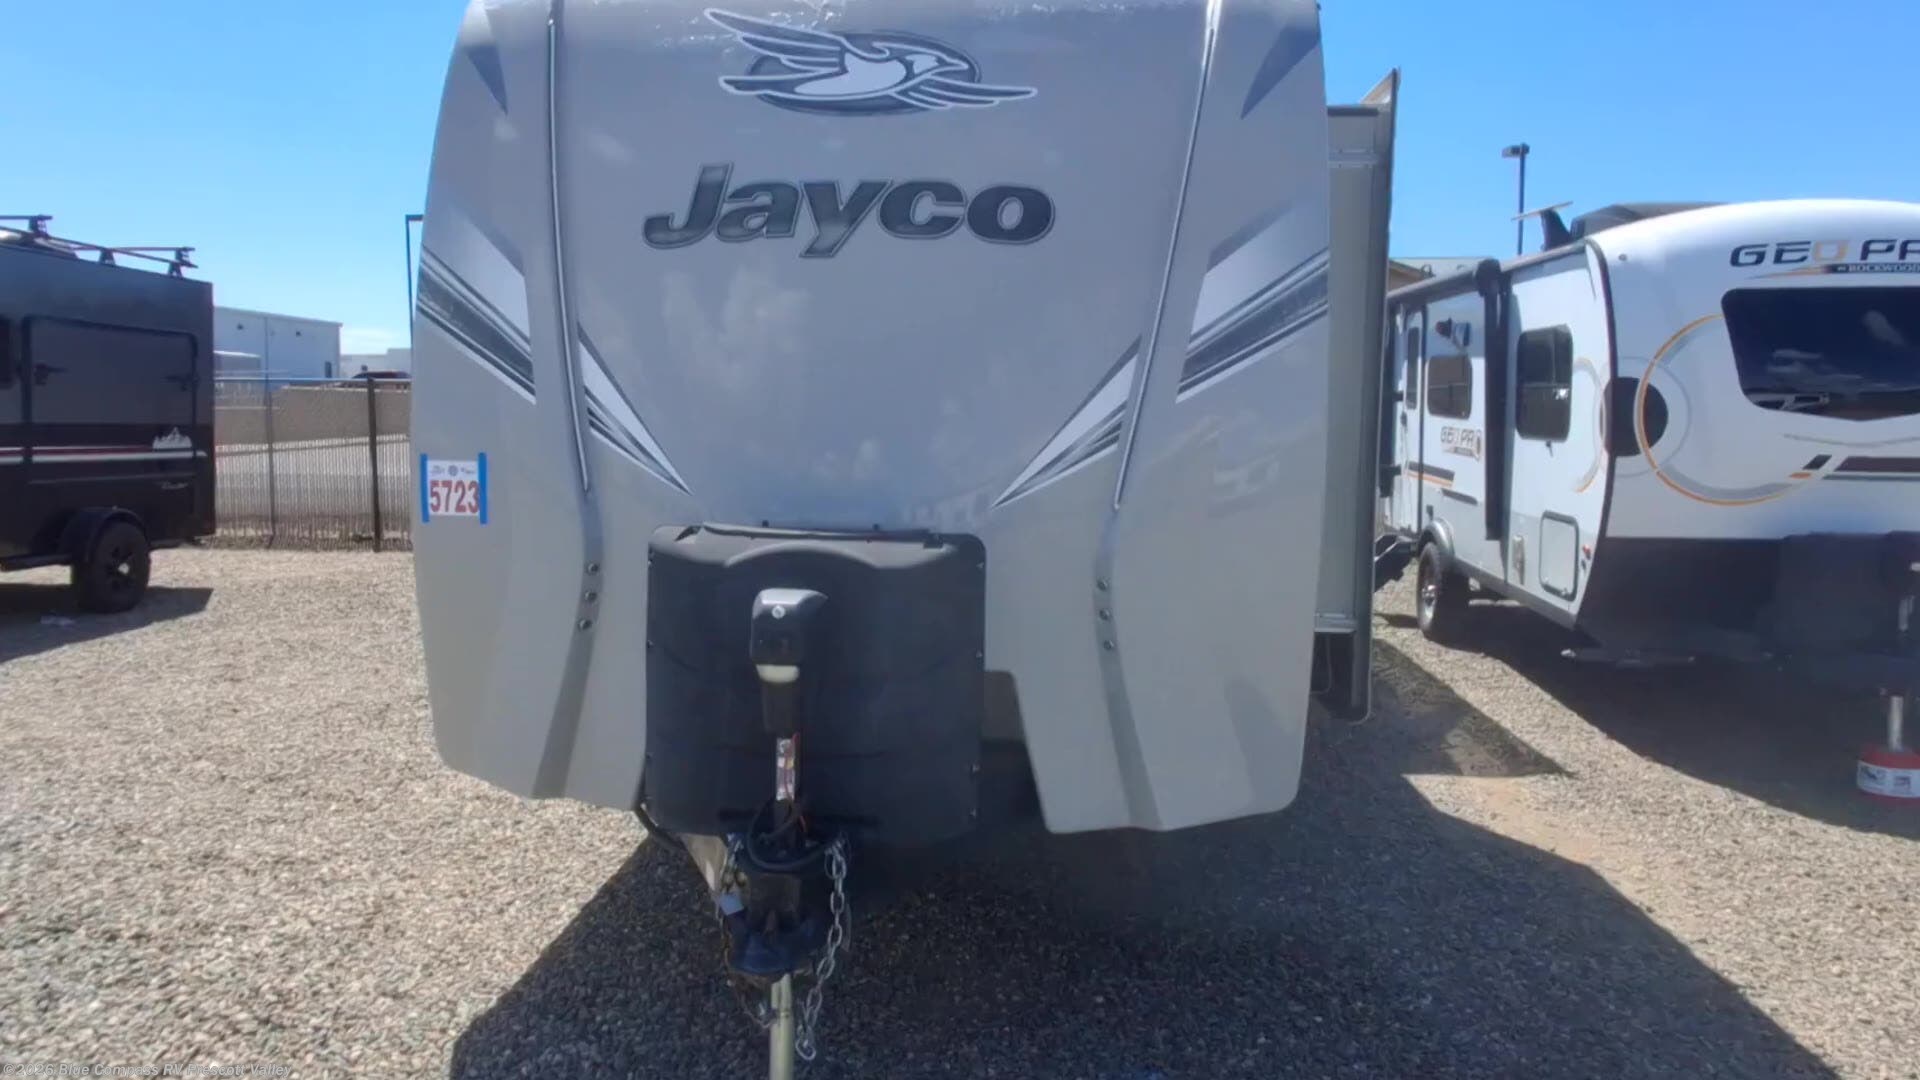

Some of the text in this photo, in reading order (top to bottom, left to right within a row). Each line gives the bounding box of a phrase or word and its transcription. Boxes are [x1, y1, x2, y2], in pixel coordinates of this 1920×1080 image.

[643, 161, 1055, 258] Jayco
[1730, 240, 1849, 267] GEO
[430, 480, 479, 514] 5723
